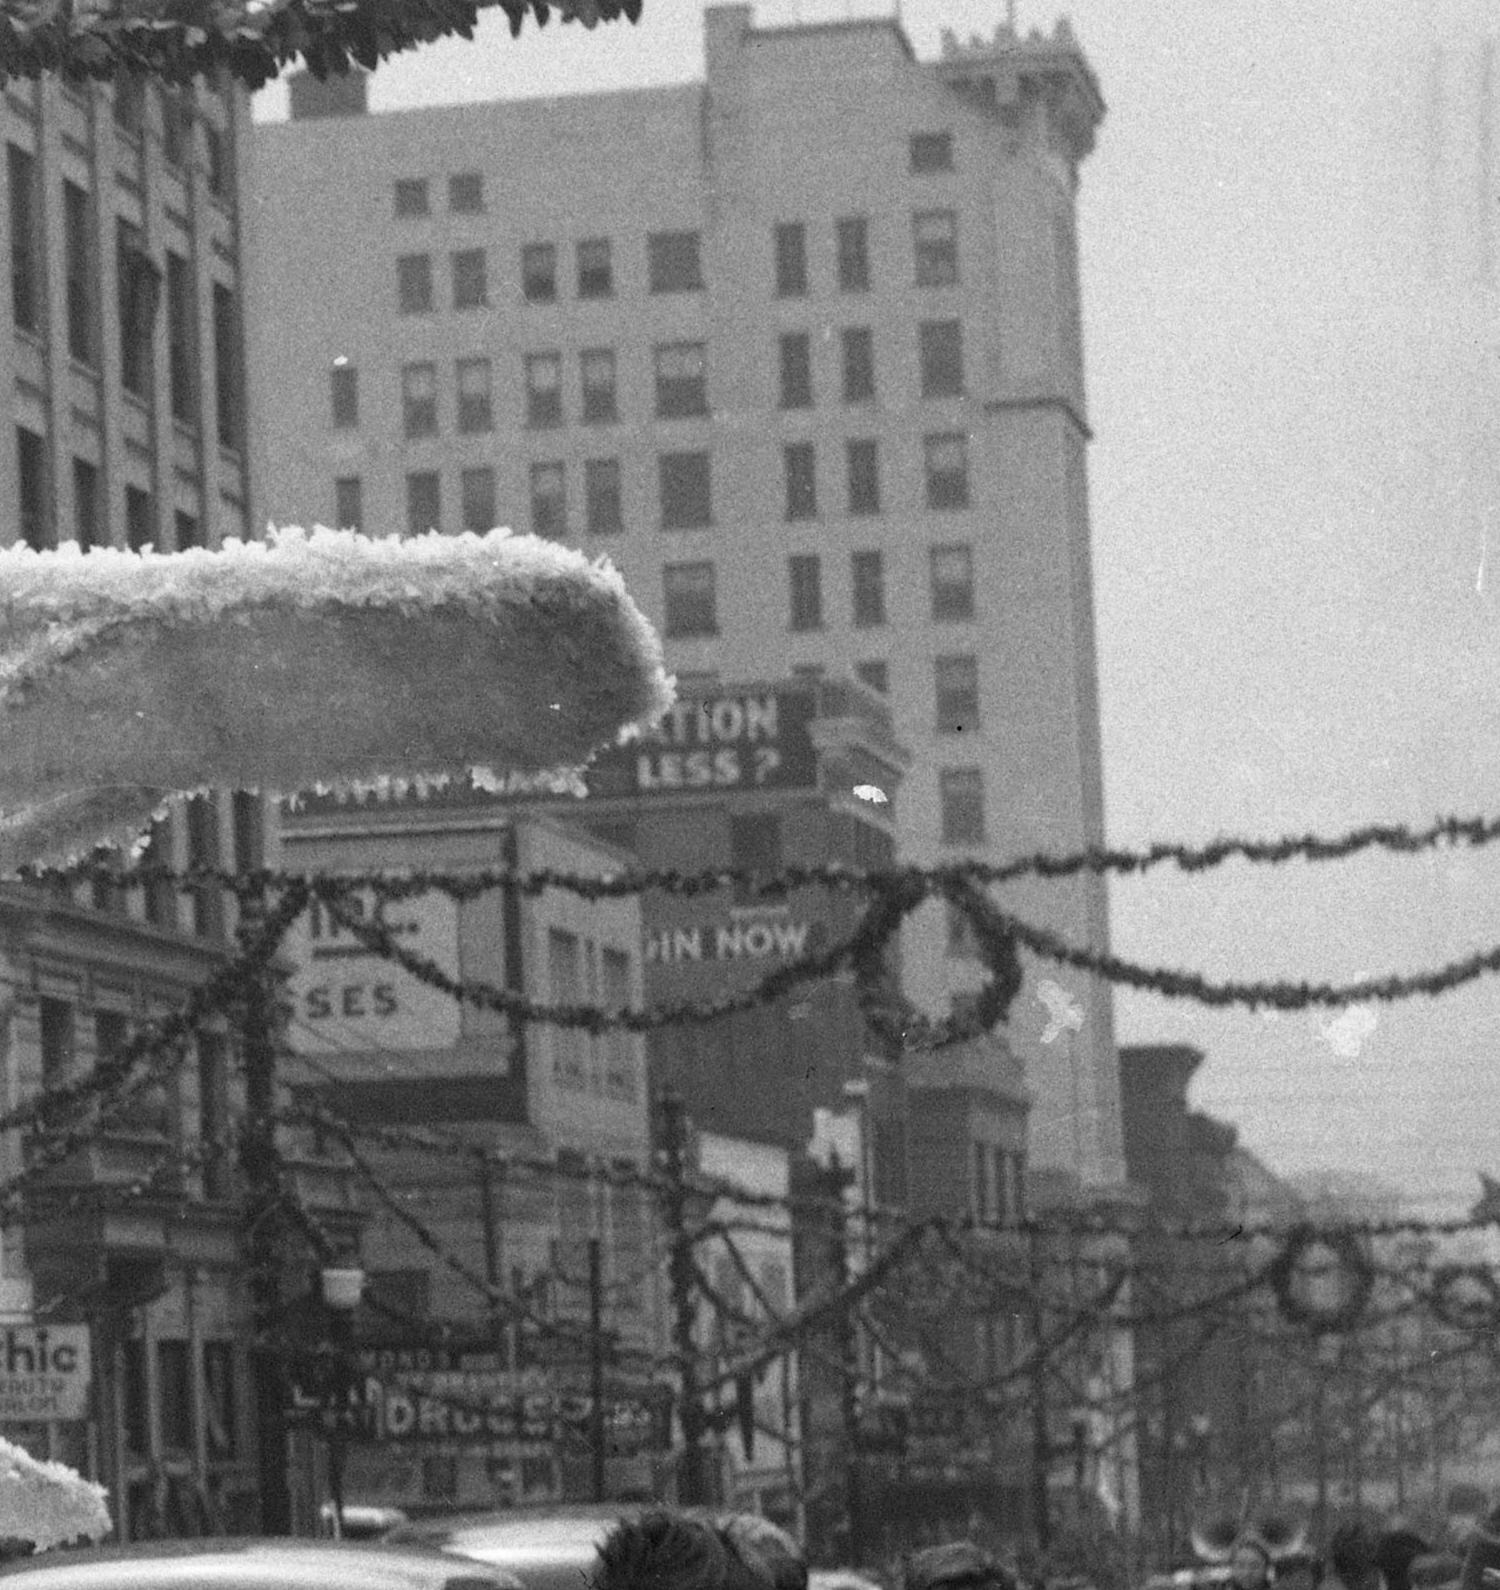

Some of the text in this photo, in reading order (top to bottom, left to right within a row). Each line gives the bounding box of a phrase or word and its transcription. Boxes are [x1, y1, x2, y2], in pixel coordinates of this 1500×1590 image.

[655, 695, 778, 743] TION
[637, 750, 741, 789] LESS
[716, 922, 808, 958] NOW
